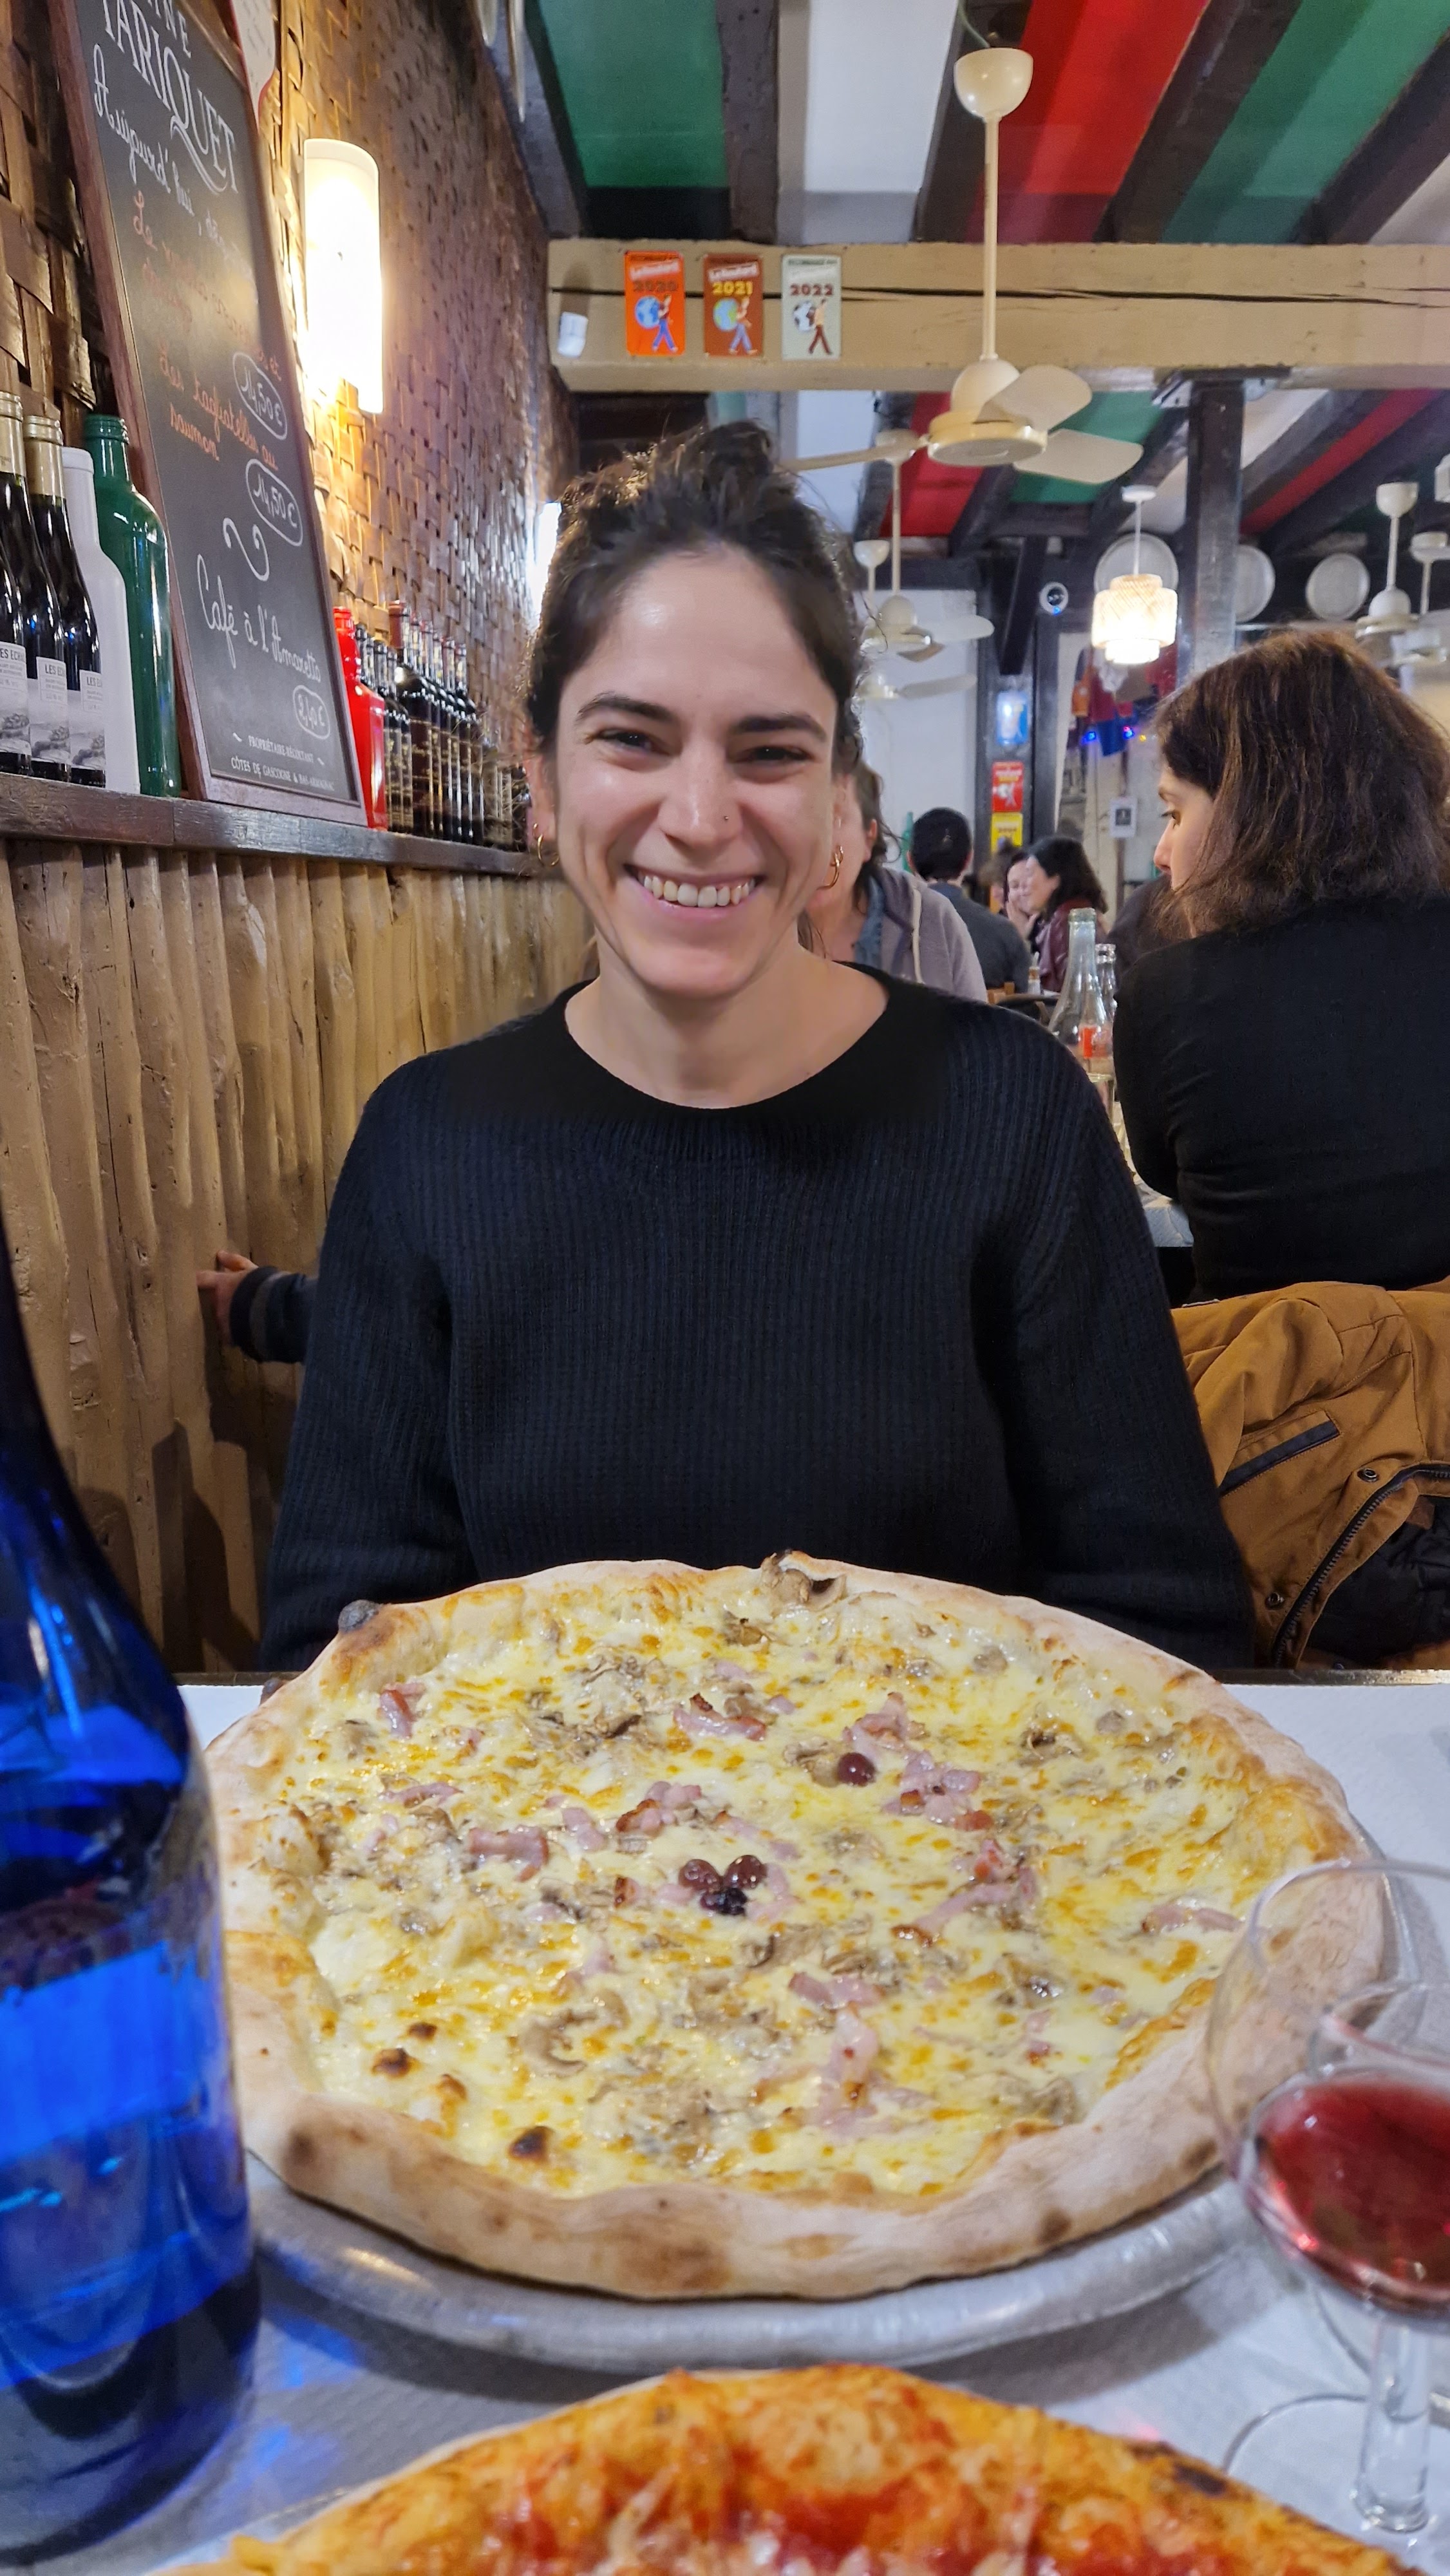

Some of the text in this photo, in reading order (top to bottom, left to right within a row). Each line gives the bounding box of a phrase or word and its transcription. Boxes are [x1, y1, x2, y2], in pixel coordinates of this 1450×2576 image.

[712, 281, 753, 296] 2021
[790, 283, 833, 296] 2022
[170, 402, 220, 462] saumon
[261, 444, 279, 471] au
[197, 553, 239, 670] Café
[244, 611, 258, 647] à
[0, 648, 8, 659] ES
[45, 664, 56, 675] LES
[231, 755, 251, 773] CÔTES
[263, 765, 292, 782] GASCOGNE
